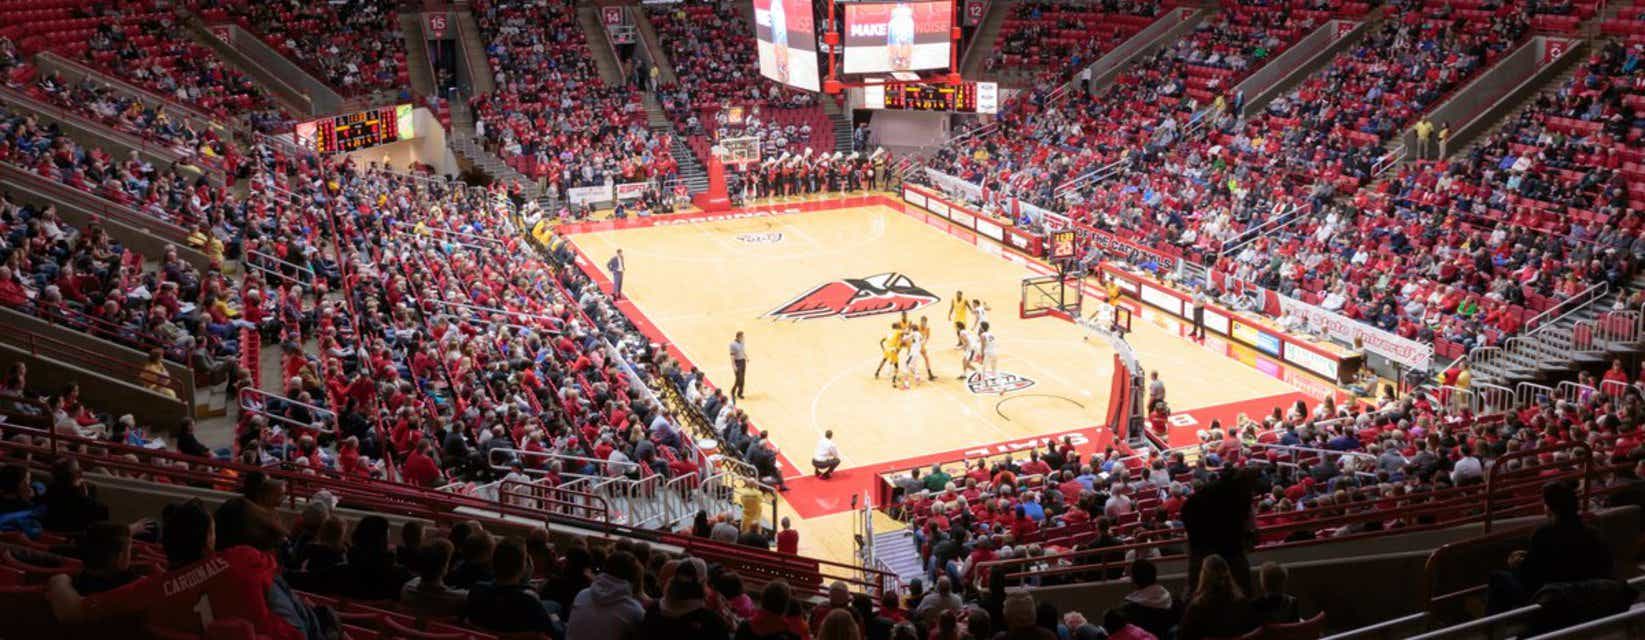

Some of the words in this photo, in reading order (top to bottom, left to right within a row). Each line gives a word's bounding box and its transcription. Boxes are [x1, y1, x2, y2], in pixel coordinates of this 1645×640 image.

[607, 11, 619, 24] 14
[970, 6, 982, 17] 12
[431, 16, 446, 30] 15
[851, 23, 887, 37] MAKE
[915, 22, 949, 34] NOISE
[1091, 231, 1109, 248] THE
[1110, 240, 1172, 269] CARDALS
[163, 557, 231, 597] CARDINALS
[193, 592, 214, 627] 1
